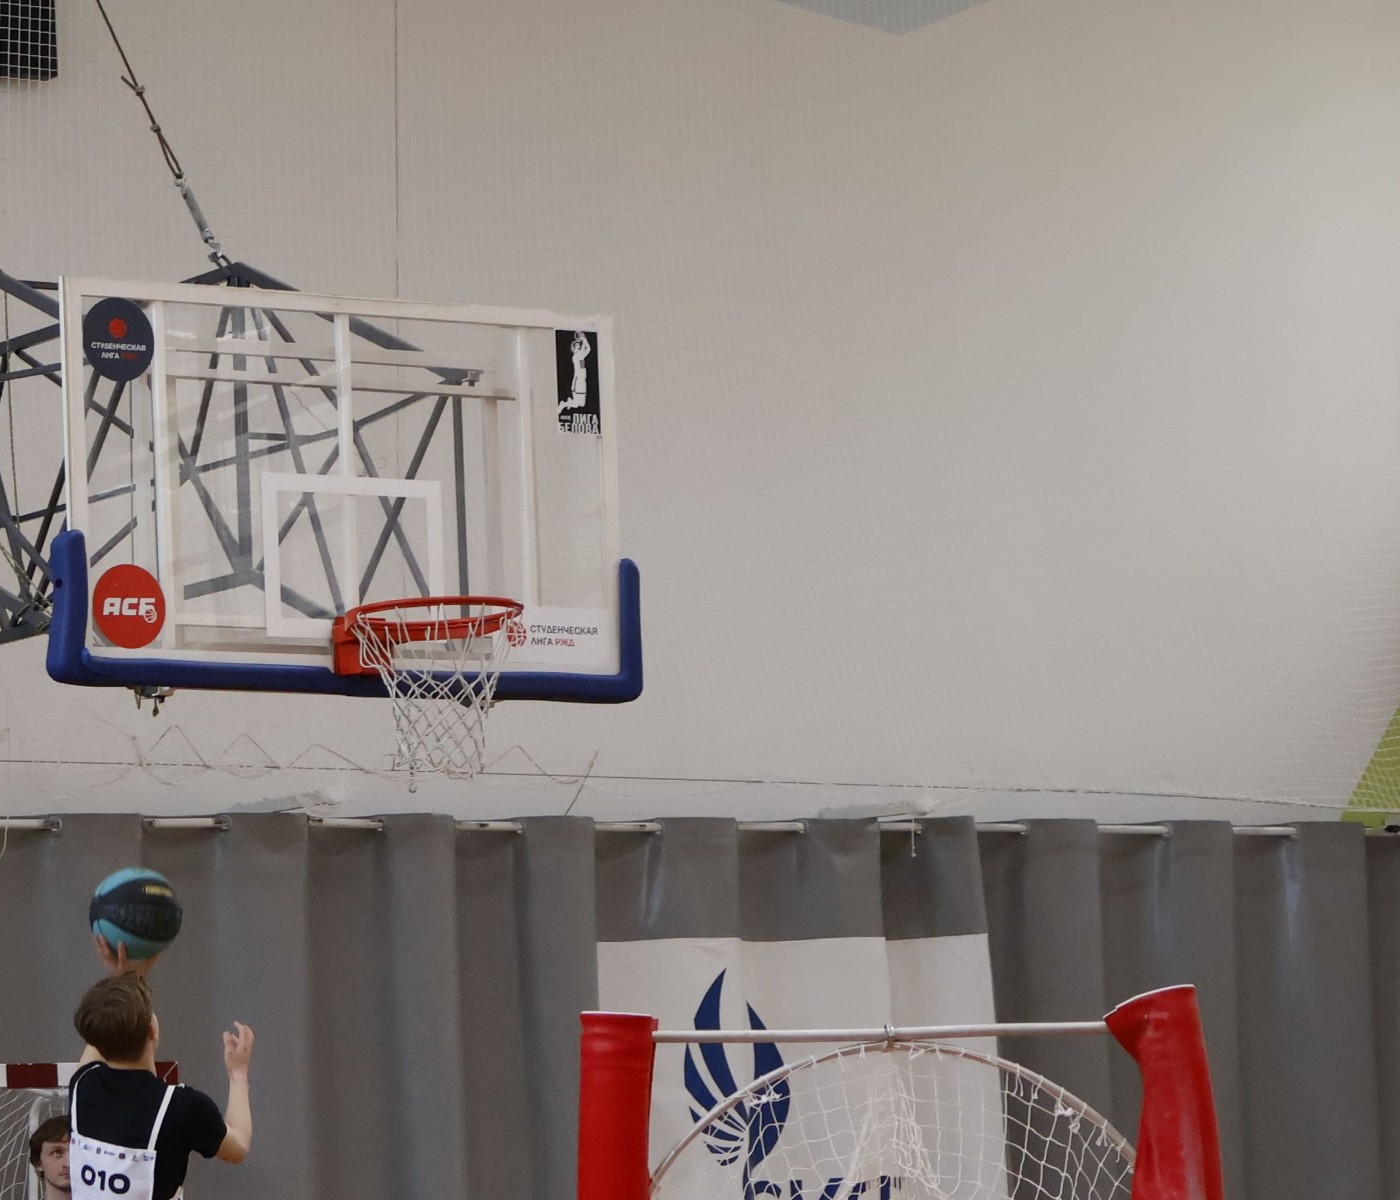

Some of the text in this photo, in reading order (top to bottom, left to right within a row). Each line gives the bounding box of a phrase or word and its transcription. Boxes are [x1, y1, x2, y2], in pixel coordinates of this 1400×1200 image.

[91, 341, 146, 351] СТУДЕНЧЕСКАЯ
[530, 625, 598, 635] СТУДЕНЧЕСКАЯ
[531, 637, 575, 646] ЛИГА РЖД
[81, 1164, 131, 1195] 010
